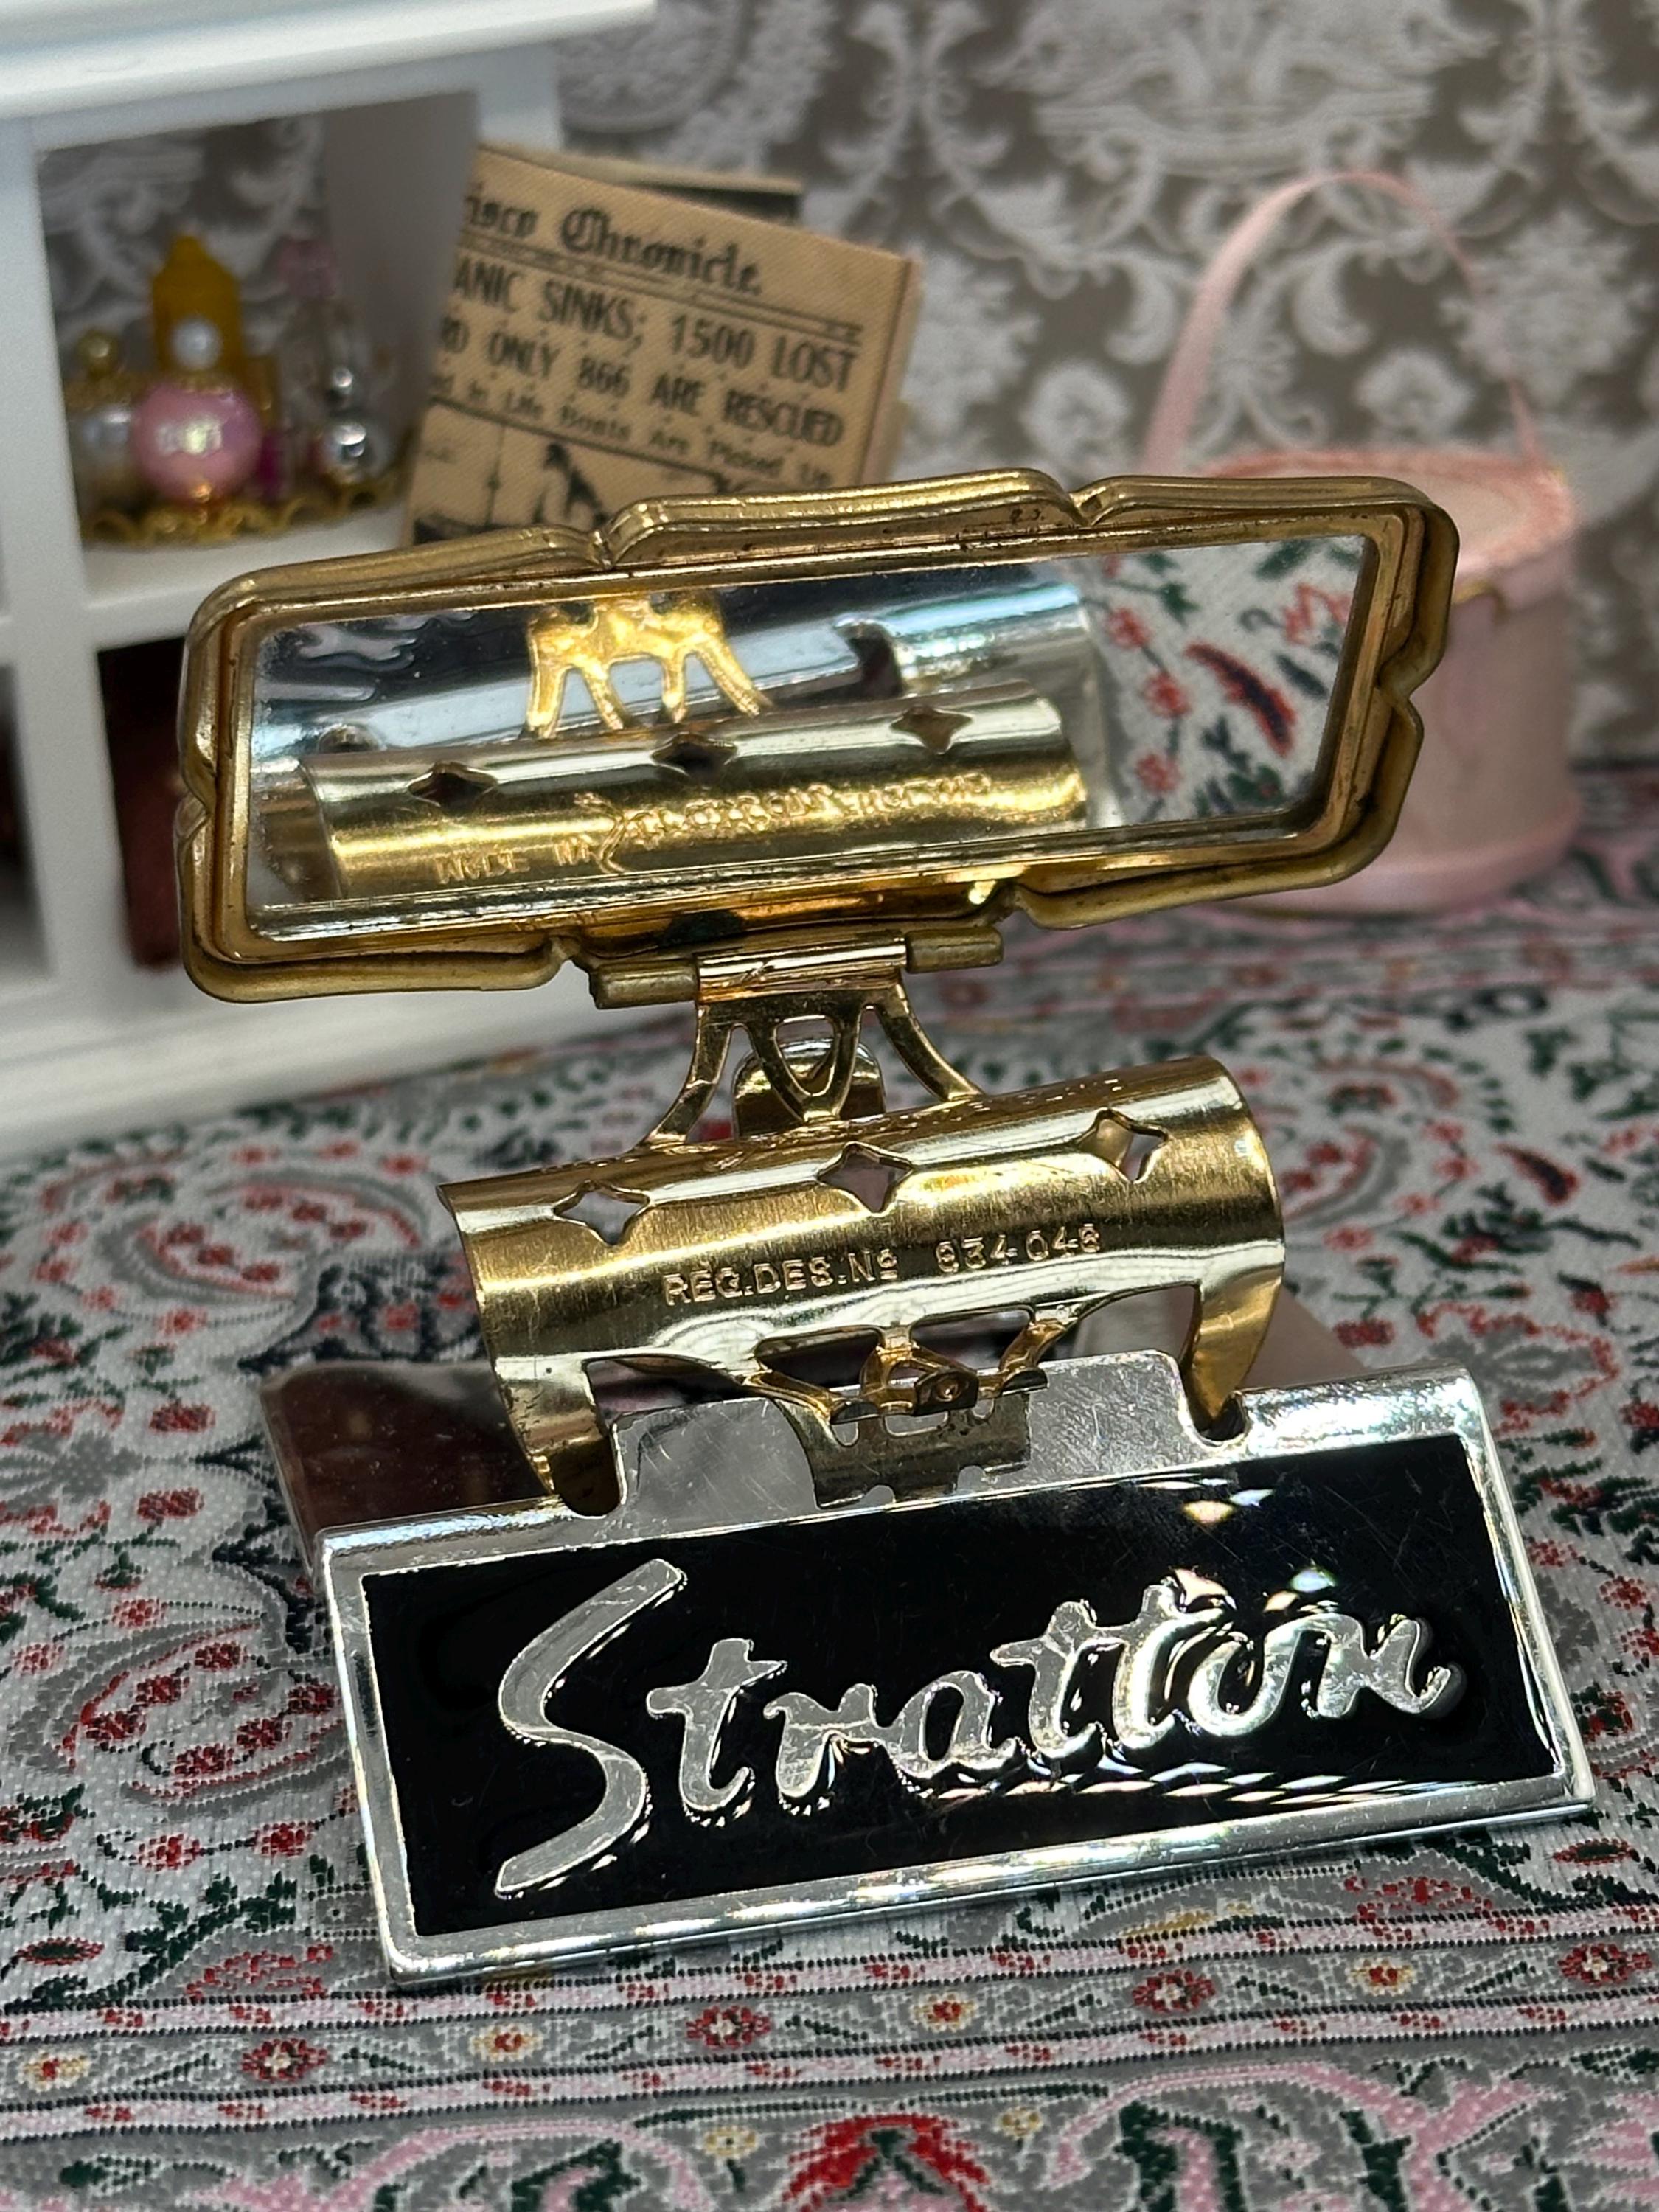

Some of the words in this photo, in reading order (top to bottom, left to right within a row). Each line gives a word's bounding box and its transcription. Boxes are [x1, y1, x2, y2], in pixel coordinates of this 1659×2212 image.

[487, 330, 561, 379] ONLY
[578, 356, 630, 399] 866
[649, 372, 706, 417] ARE
[722, 389, 846, 448] RESCUED
[672, 313, 756, 369] 1500
[772, 335, 858, 392] LOST
[495, 1557, 1458, 1899] Stratton
